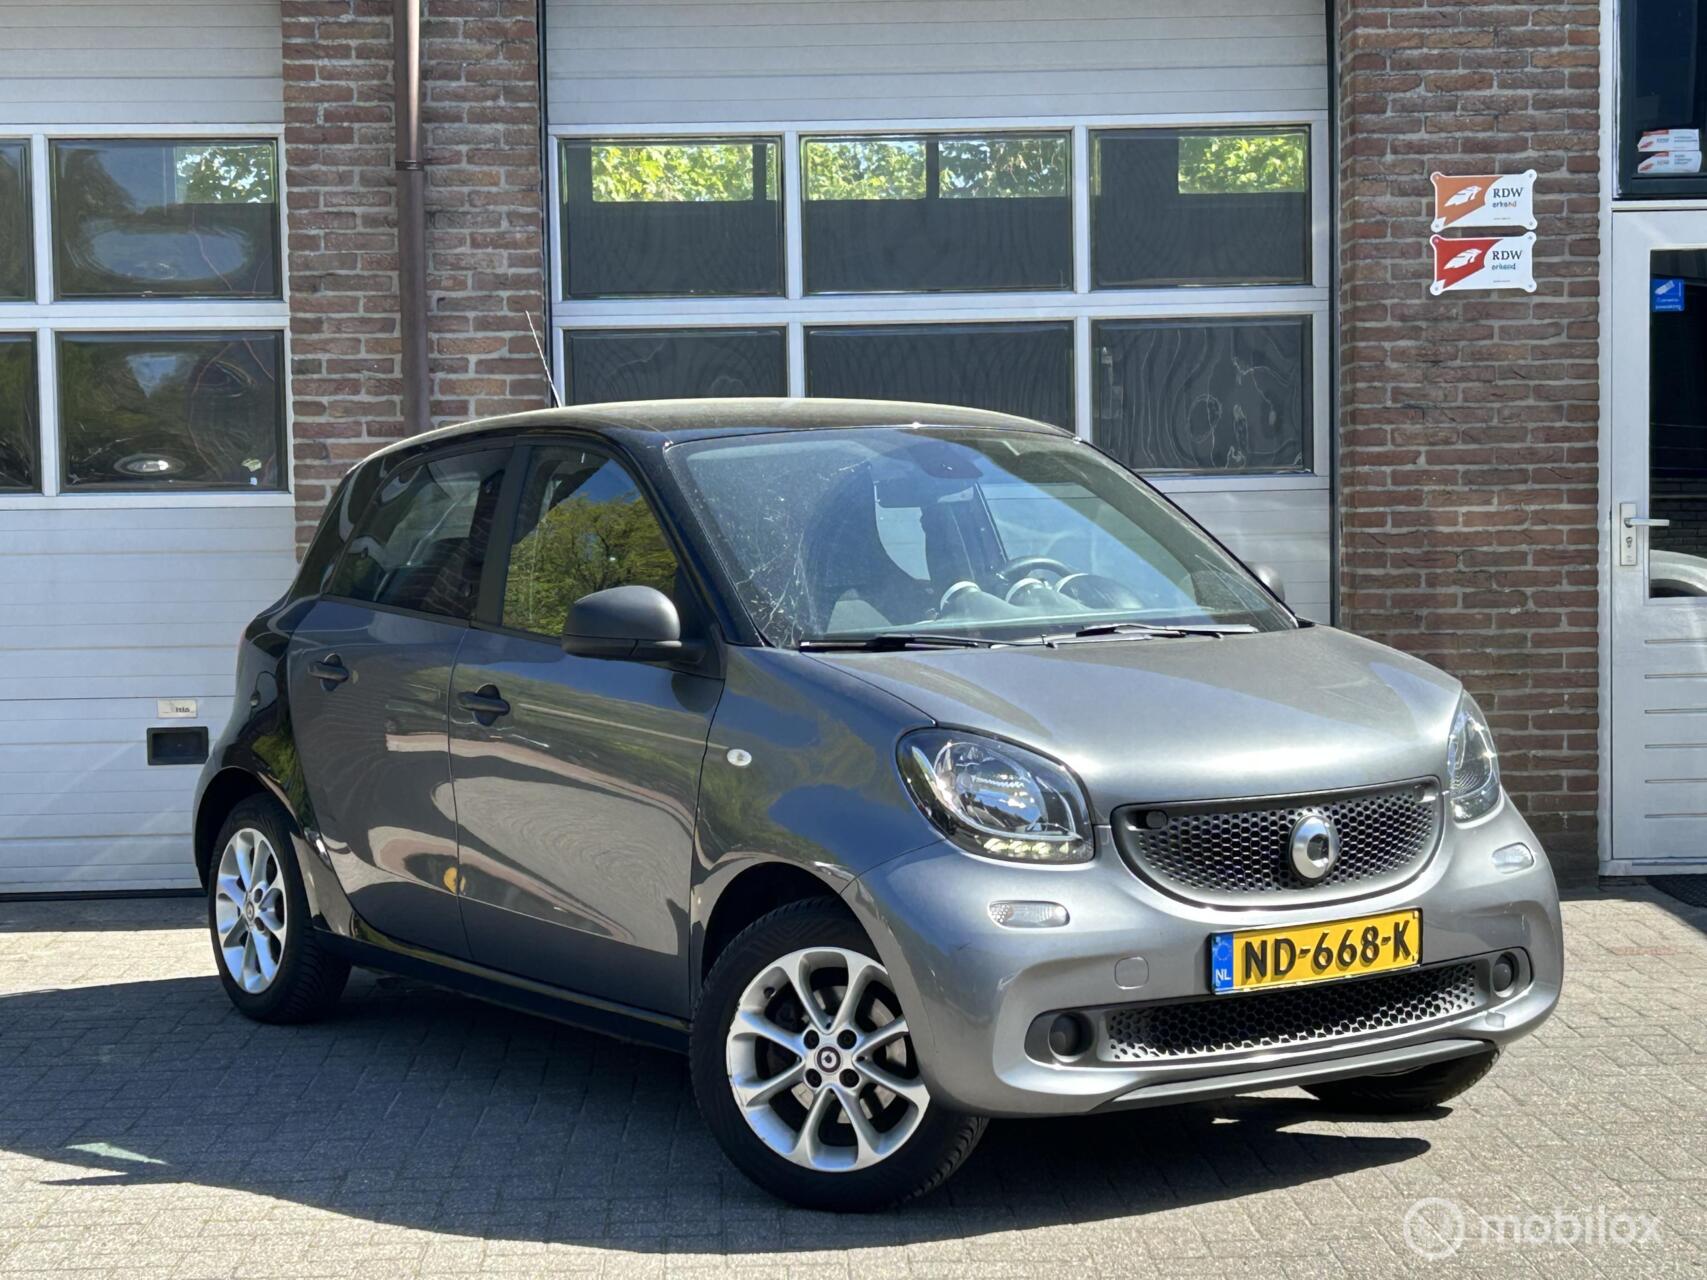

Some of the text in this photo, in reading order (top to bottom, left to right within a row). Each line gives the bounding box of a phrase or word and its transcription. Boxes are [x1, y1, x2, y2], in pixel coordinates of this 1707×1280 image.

[1493, 187, 1523, 198] RDW
[1492, 250, 1522, 260] RDW
[1244, 919, 1411, 980] ND-668-K
[1215, 968, 1231, 981] NL
